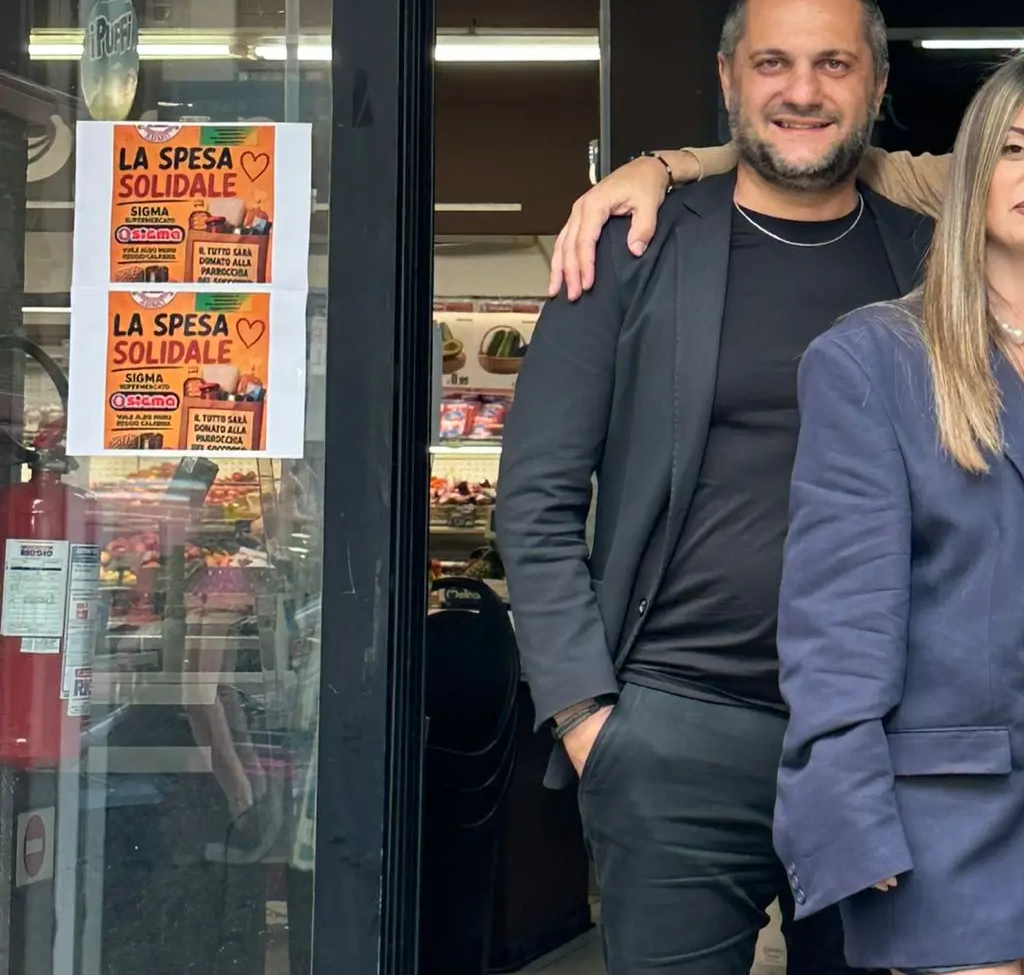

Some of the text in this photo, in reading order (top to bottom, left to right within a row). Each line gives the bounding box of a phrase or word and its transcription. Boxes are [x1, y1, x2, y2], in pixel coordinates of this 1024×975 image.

[118, 146, 234, 171] LA SPESA
[117, 172, 237, 199] SOLIDALE
[130, 206, 169, 216] SIGMA
[207, 247, 231, 256] TUTTO
[232, 258, 252, 267] ALLA
[113, 312, 229, 337] LA SPESA
[112, 339, 233, 365] SOLIDALE
[125, 372, 163, 383] SIGMA
[202, 414, 226, 423] TUTTO
[194, 424, 247, 434] DONATO ALLA
